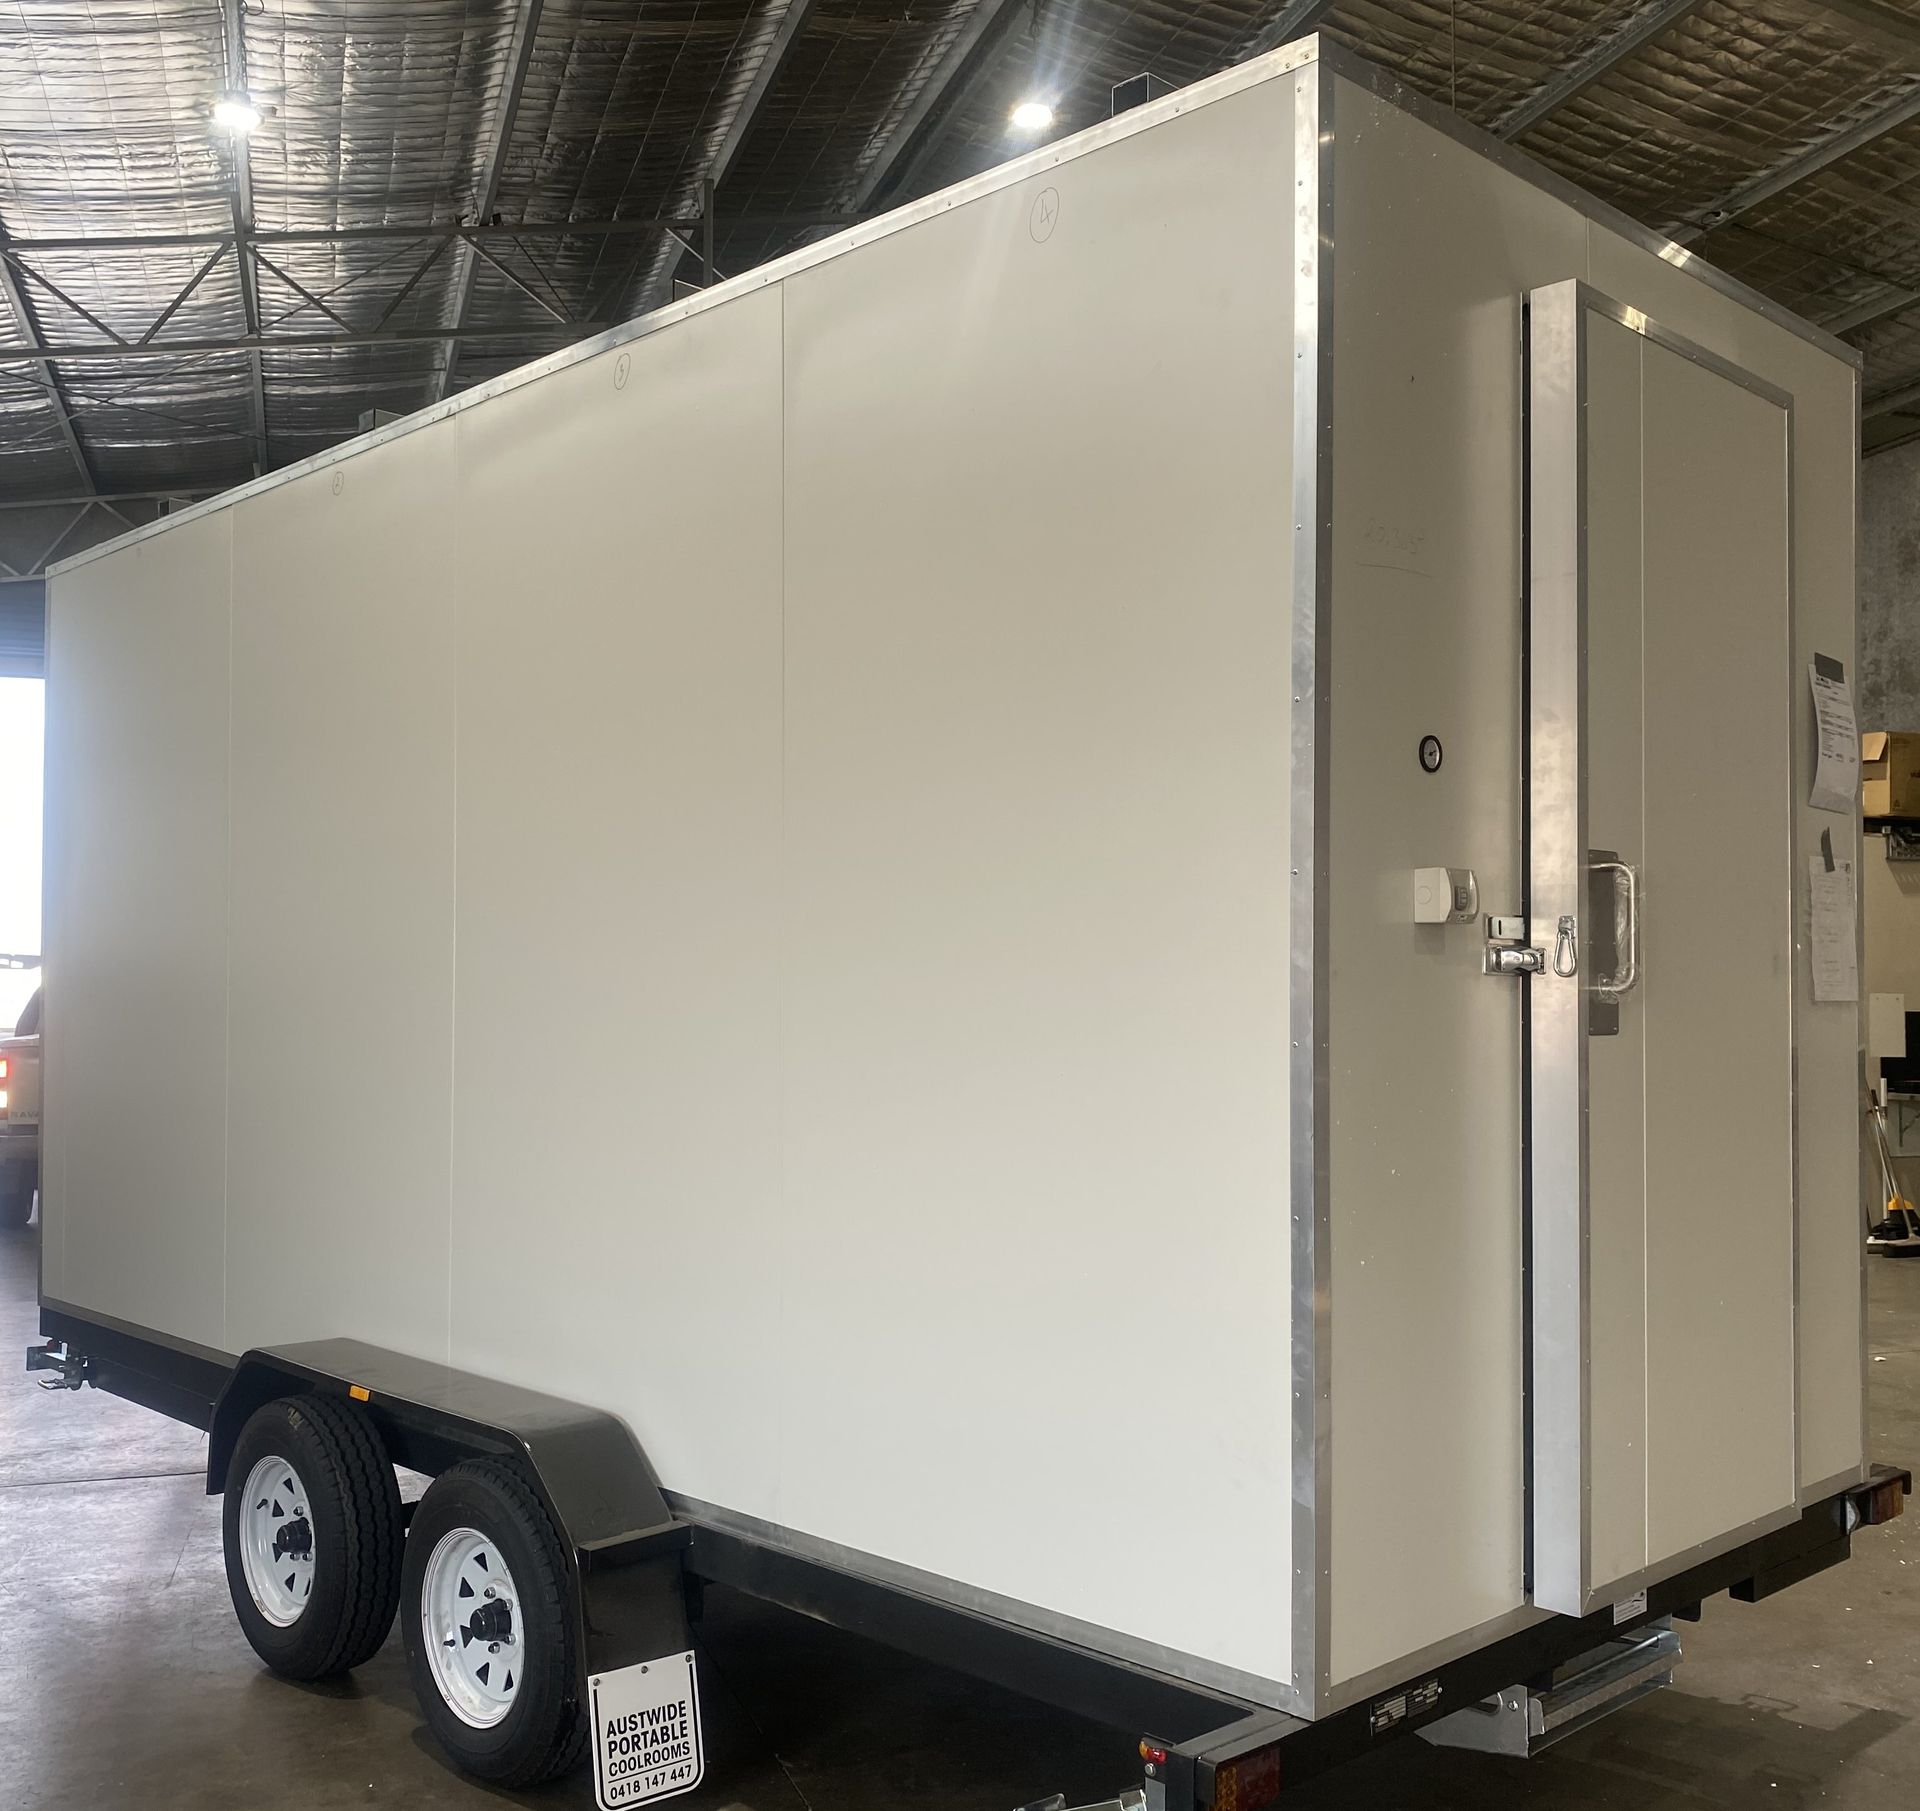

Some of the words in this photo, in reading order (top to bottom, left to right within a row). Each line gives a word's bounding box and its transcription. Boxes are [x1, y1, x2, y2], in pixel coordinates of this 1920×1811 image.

[606, 1700, 687, 1739] AUSTWIDE
[608, 1720, 688, 1759] PORTABLE
[608, 1741, 690, 1777] COOLROOMS
[610, 1780, 641, 1800] 0418
[644, 1772, 666, 1790] 147
[670, 1764, 692, 1782] 447
